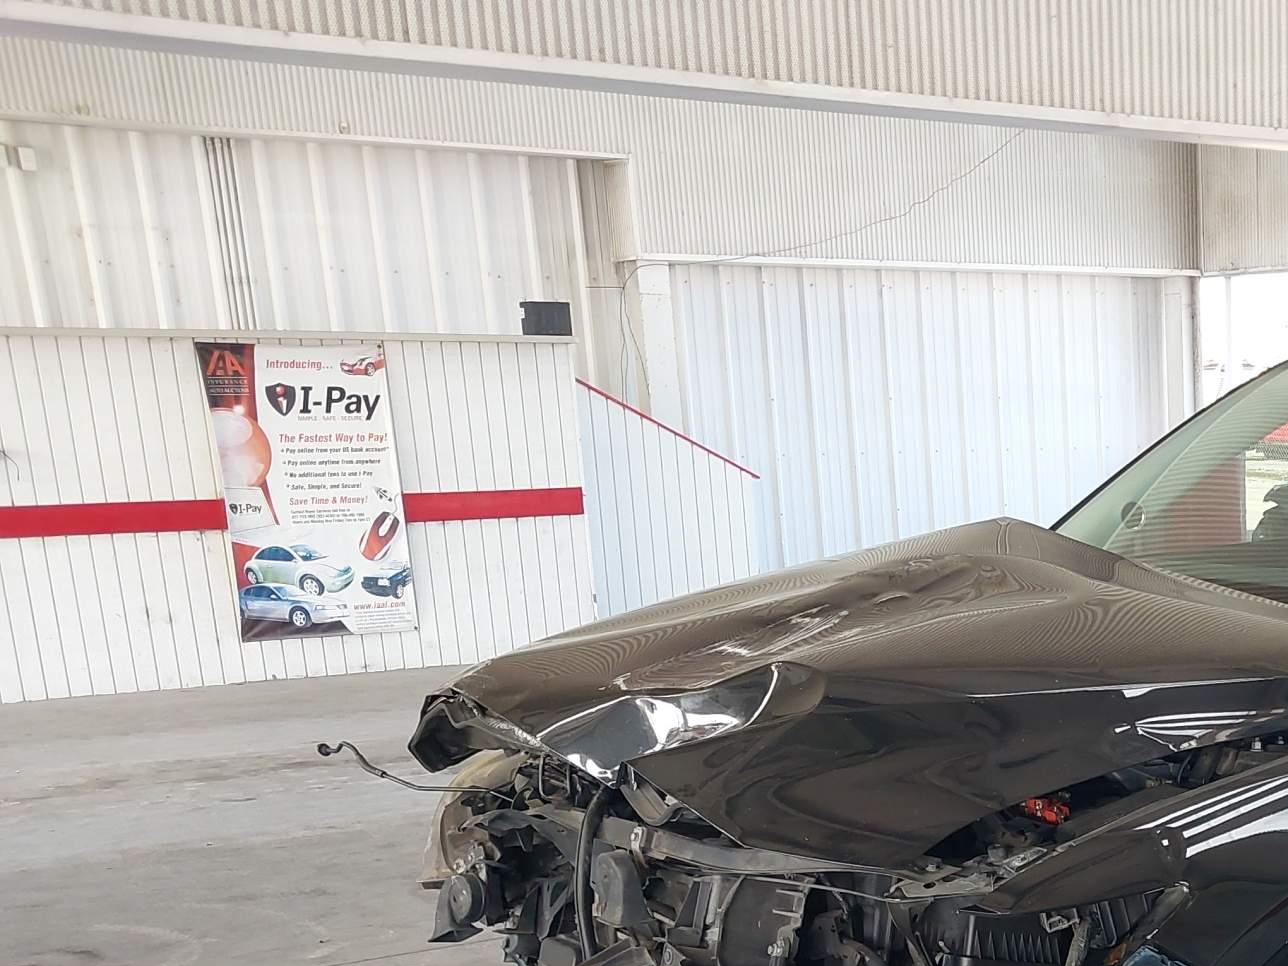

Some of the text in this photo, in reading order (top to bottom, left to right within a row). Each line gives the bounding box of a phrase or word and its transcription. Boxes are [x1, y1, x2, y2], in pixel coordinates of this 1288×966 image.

[299, 386, 381, 421] I-Pay
[279, 432, 388, 444] The Fastest Way to Pay!
[289, 497, 308, 505] Save
[310, 497, 329, 505] Time
[340, 496, 368, 505] Money!
[238, 503, 262, 514] I-Pay
